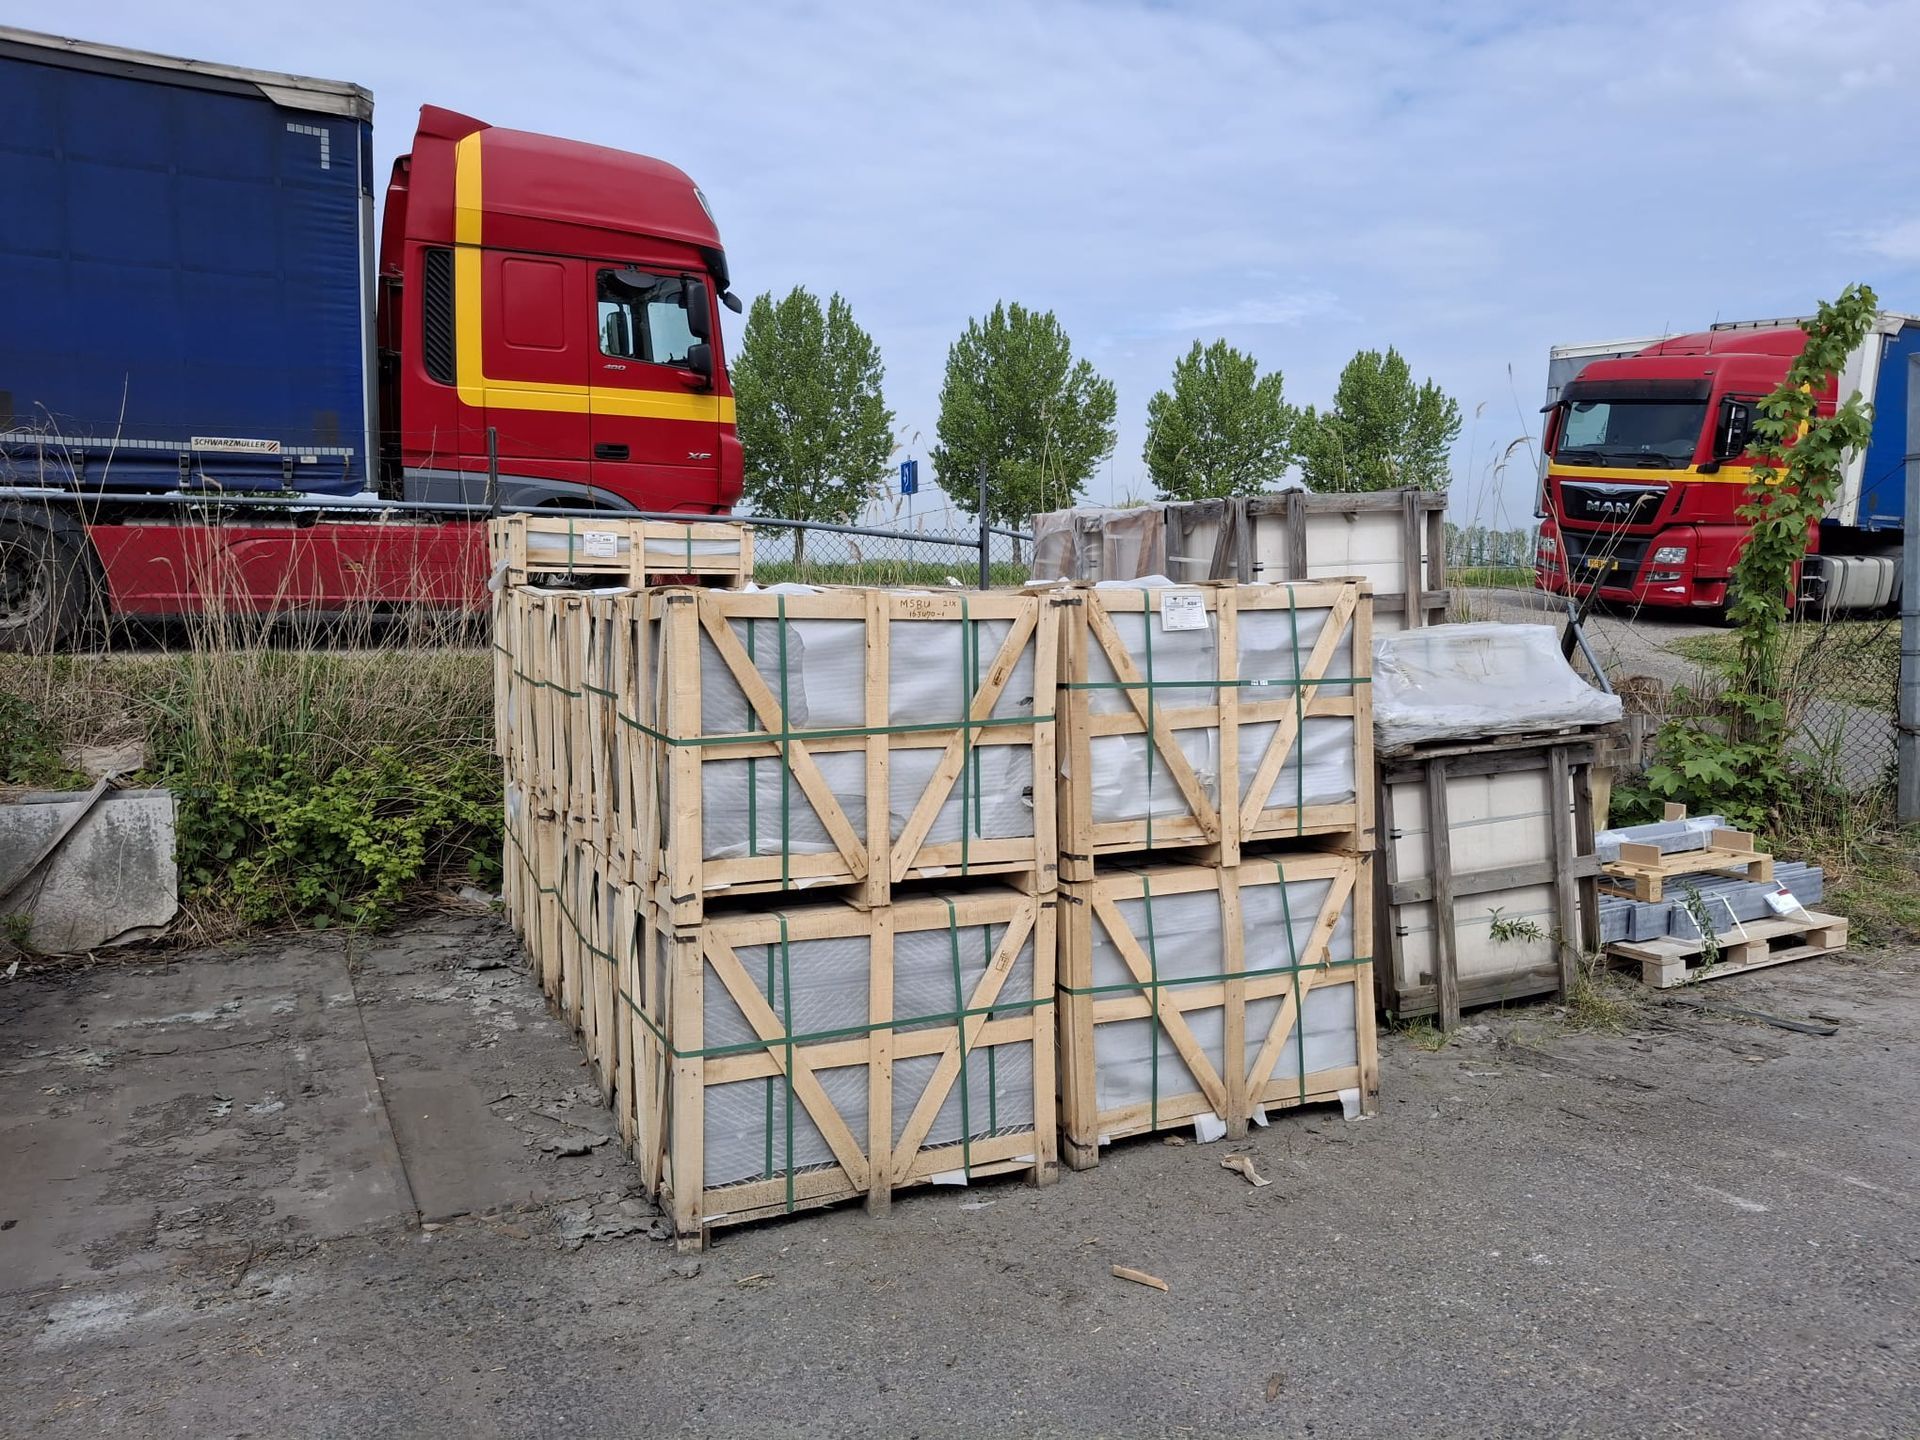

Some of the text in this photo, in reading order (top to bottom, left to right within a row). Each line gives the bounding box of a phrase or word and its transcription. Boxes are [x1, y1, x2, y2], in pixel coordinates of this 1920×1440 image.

[687, 451, 712, 460] XF
[1586, 500, 1630, 513] MAN
[900, 599, 931, 610] MSBU
